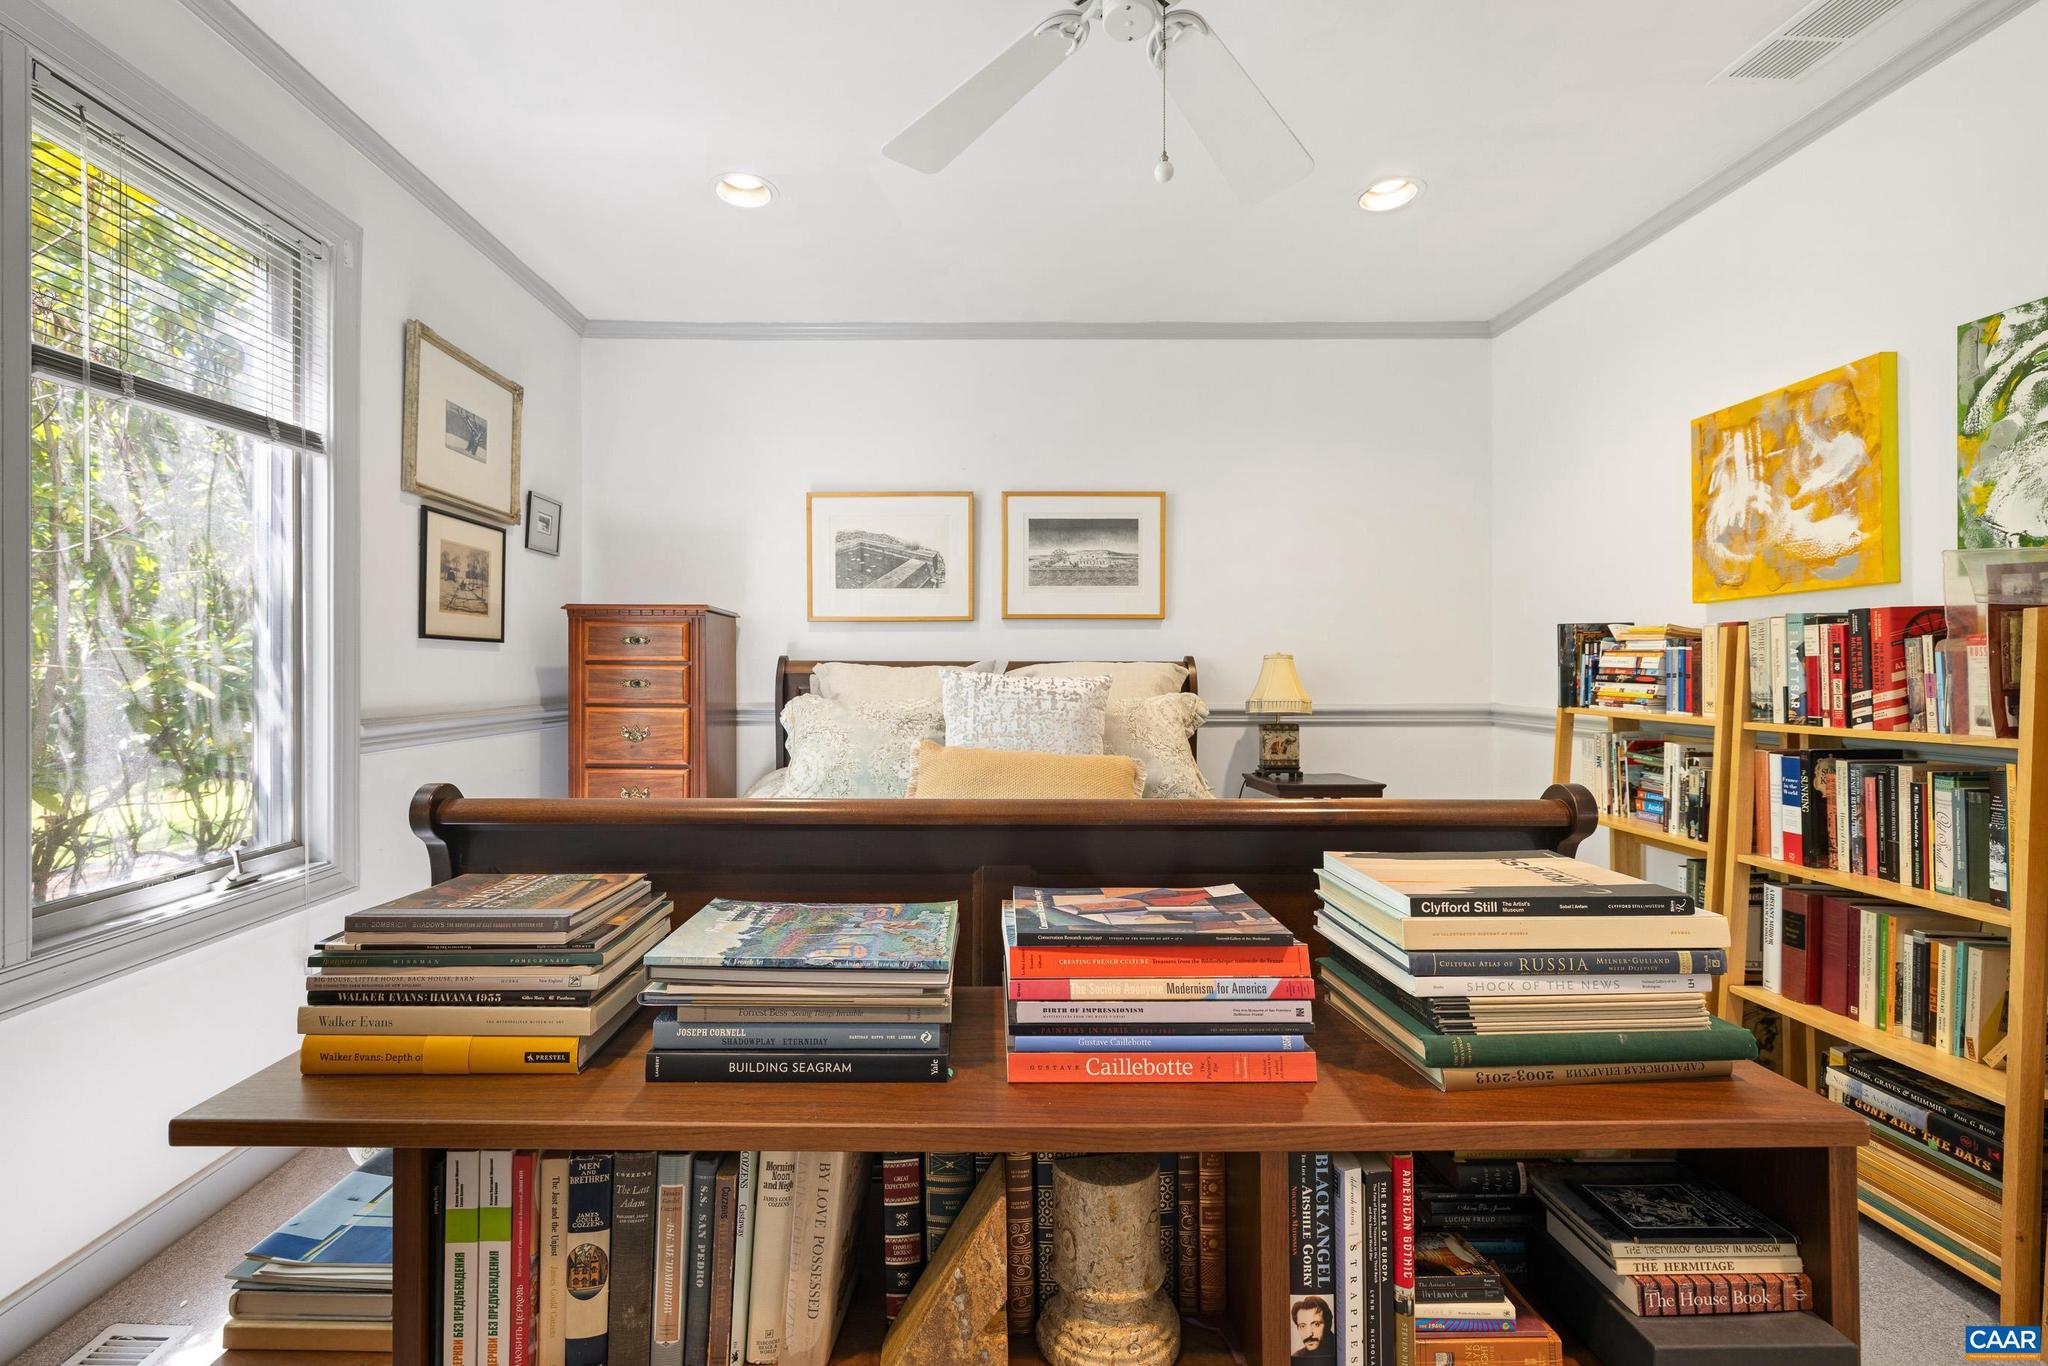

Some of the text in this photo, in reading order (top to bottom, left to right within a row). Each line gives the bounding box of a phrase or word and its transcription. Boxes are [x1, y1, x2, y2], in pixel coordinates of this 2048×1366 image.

[1856, 636, 1864, 671] BETWEEN
[1789, 640, 1801, 709] LAST TSAR
[1782, 776, 1799, 784] France
[1421, 901, 1498, 915] Clyfford Still
[1519, 957, 1589, 971] RUSSIA
[1596, 957, 1670, 965] MILNER-GULLAND
[1088, 981, 1268, 995] Société Modernism for America
[1466, 979, 1621, 992] SHOCK OF THE NEWS
[338, 992, 473, 1002] WALKER EVANS: HAVANA
[738, 1008, 788, 1017] Forrest Bess
[319, 1015, 393, 1027] Walker Evans
[676, 1028, 746, 1037] JOSEPH CORNELL
[1041, 1026, 1085, 1034] PAINTERS
[722, 1038, 829, 1047] SHADOWPLAY ETERNIDAY
[1078, 1037, 1152, 1046] Gustave Caillebotte
[320, 1053, 353, 1062] Walker
[354, 1053, 384, 1062] Evans:
[385, 1053, 414, 1064] Depth
[729, 1058, 939, 1076] BUILDING SEAGRAM Yale
[1086, 1058, 1193, 1076] Caillebotte
[1475, 1061, 1705, 1085] САРАТОВСКАЯ ЕПАРХИЯ 2003-2013
[1848, 1066, 1948, 1115] TOMBS, GRAVES MUMMIES
[1855, 1099, 1992, 1171] GONE ARE THE DAYS
[578, 1162, 601, 1171] MEN
[569, 1174, 610, 1185] BRETHREN
[771, 1172, 791, 1181] Noon
[616, 1184, 650, 1195] The Last
[763, 1181, 778, 1190] and
[884, 1182, 919, 1190] EXPECTATIONS
[738, 1151, 750, 1238] COZZENS Castaway
[1349, 1175, 1360, 1226] deborah davis
[620, 1198, 646, 1208] Adam
[720, 1186, 731, 1220] Cozzens
[550, 1176, 561, 1257] The Just and the Unjust
[1315, 1154, 1331, 1288] BLACK ANGEL
[571, 1220, 604, 1229] COZZENS
[1402, 1169, 1413, 1279] AMERICAN GOTHIC
[695, 1184, 709, 1288] S.S. SAN PEDRO
[807, 1162, 832, 1320] BY LOVE POSSESSED
[1301, 1184, 1314, 1288] ARSHILE GORKY
[1381, 1230, 1387, 1243] OF
[1624, 1244, 1781, 1255] THE TRETYAKOV GALLERY IN MOSCOW
[1632, 1261, 1735, 1272] THE HERMITAGE
[487, 1250, 500, 1337] ПРЕДУБЕЖДЕНИЯ БЕЗ
[663, 1260, 674, 1315] TOMORROW
[453, 1252, 465, 1338] ПРЕДУБЕЖДЕНИЯ БЕЗ
[1645, 1288, 1771, 1308] The House Book
[515, 1284, 524, 1323] ЦЕРКОВЬ
